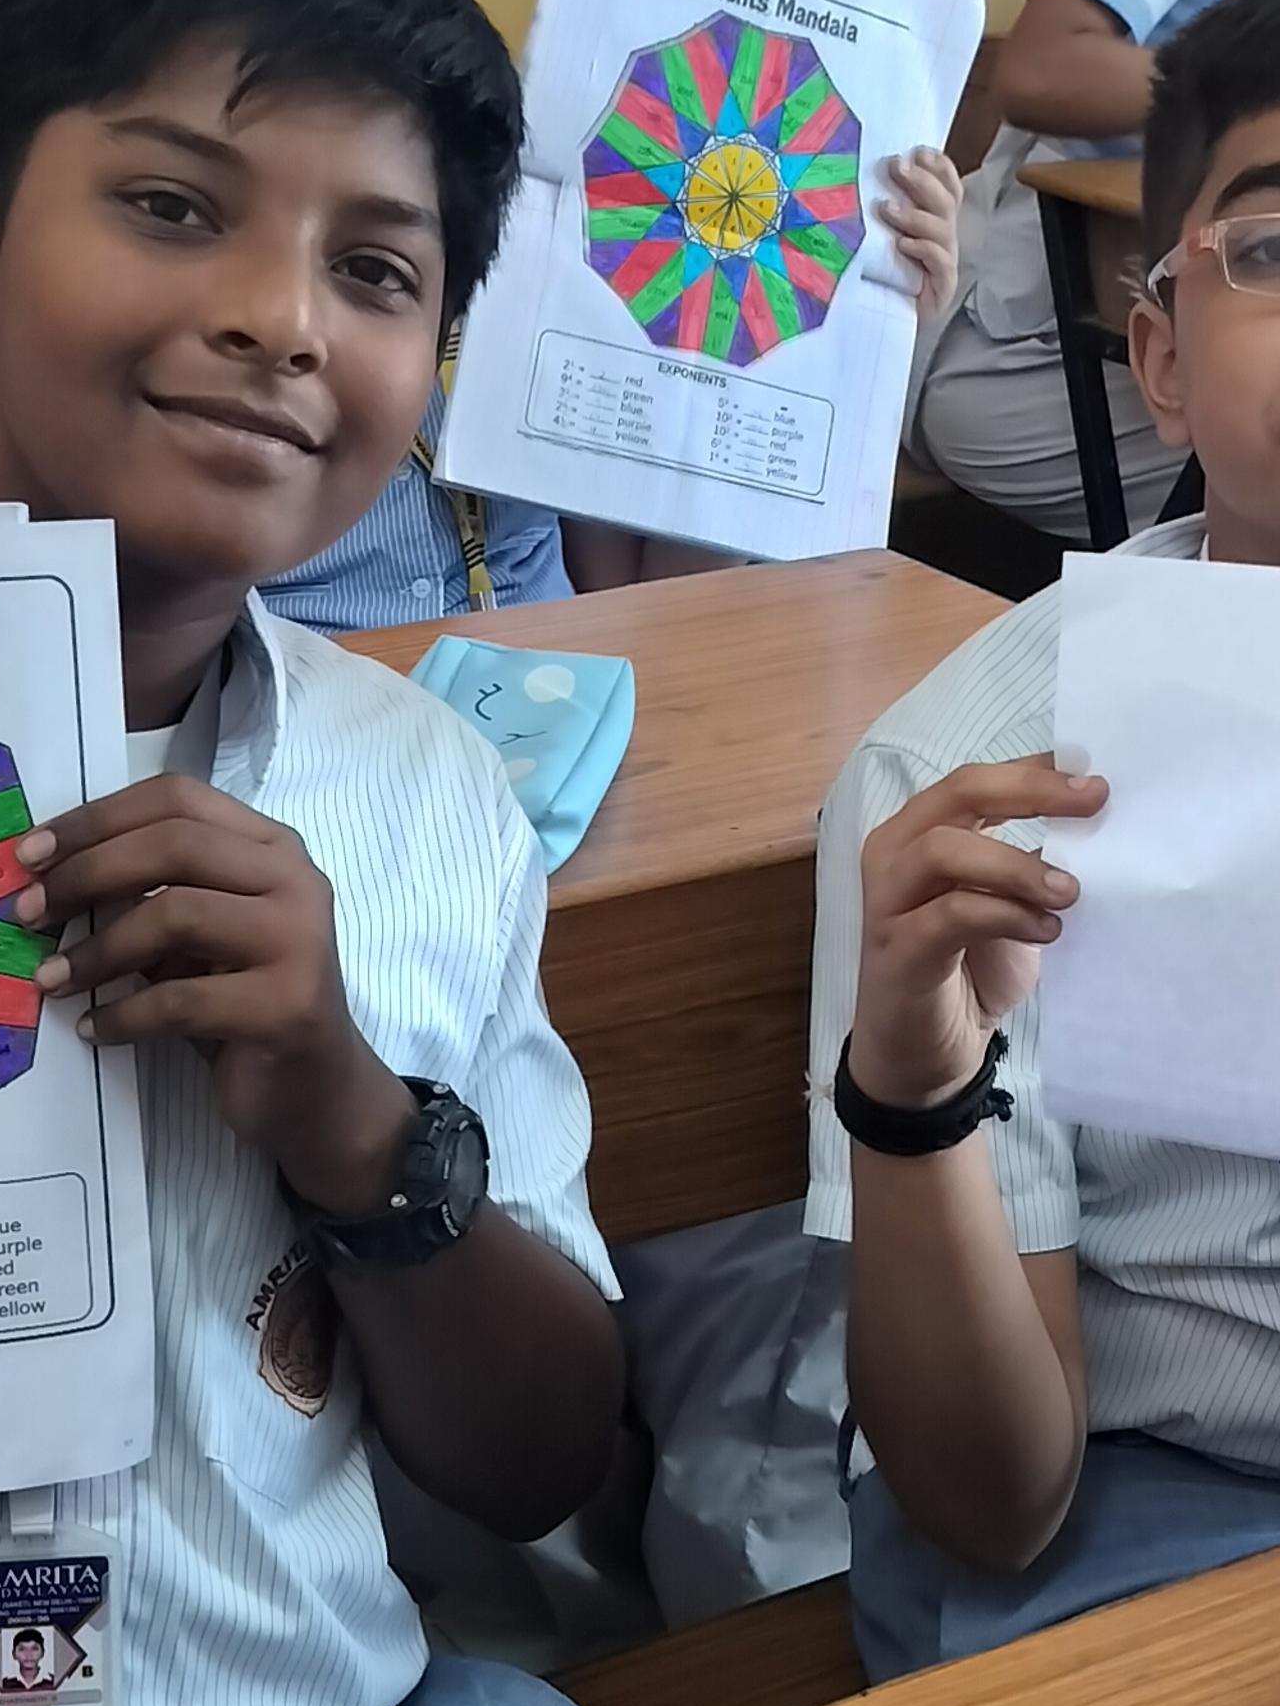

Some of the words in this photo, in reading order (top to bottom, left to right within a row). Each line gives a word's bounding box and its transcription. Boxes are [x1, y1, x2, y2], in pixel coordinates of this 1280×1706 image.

[658, 361, 727, 388] EXPONENTS
[774, 411, 796, 425] blue
[772, 425, 804, 442] purple
[767, 454, 797, 468] green
[765, 466, 798, 482] yellow
